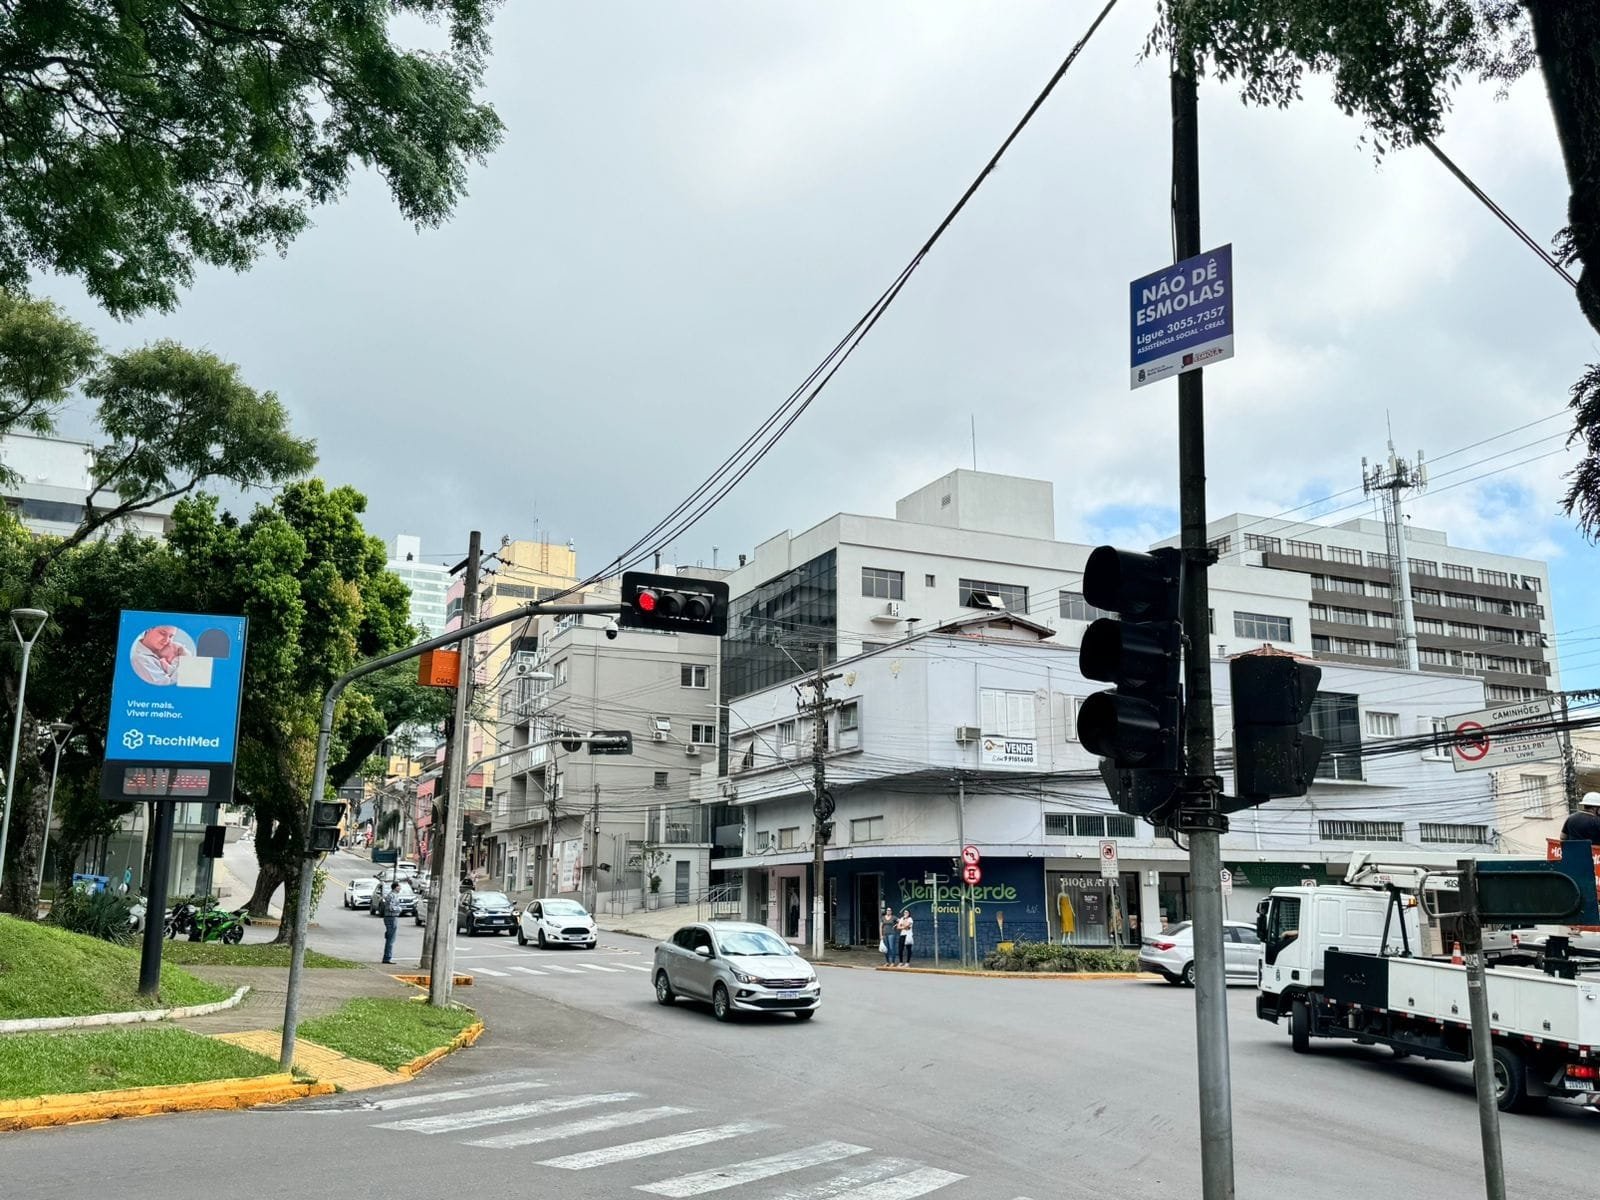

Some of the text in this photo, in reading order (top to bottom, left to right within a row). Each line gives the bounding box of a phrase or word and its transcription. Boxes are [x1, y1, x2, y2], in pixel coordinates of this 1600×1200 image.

[1142, 258, 1217, 305] NÃO DÊ
[1136, 280, 1225, 326] ESMOLAS
[1136, 306, 1225, 345] Ligue 3055.7357
[1137, 336, 1175, 354] ASSISTÊNCIA
[1175, 328, 1199, 341] SOCIAL
[1204, 319, 1225, 331] CREAS
[127, 700, 175, 710] Viver mais.
[1492, 704, 1540, 720] CAMINHÕES
[126, 709, 183, 719] Viver melhor.
[147, 734, 220, 747] TacchiMed
[1005, 742, 1033, 755] VENDE
